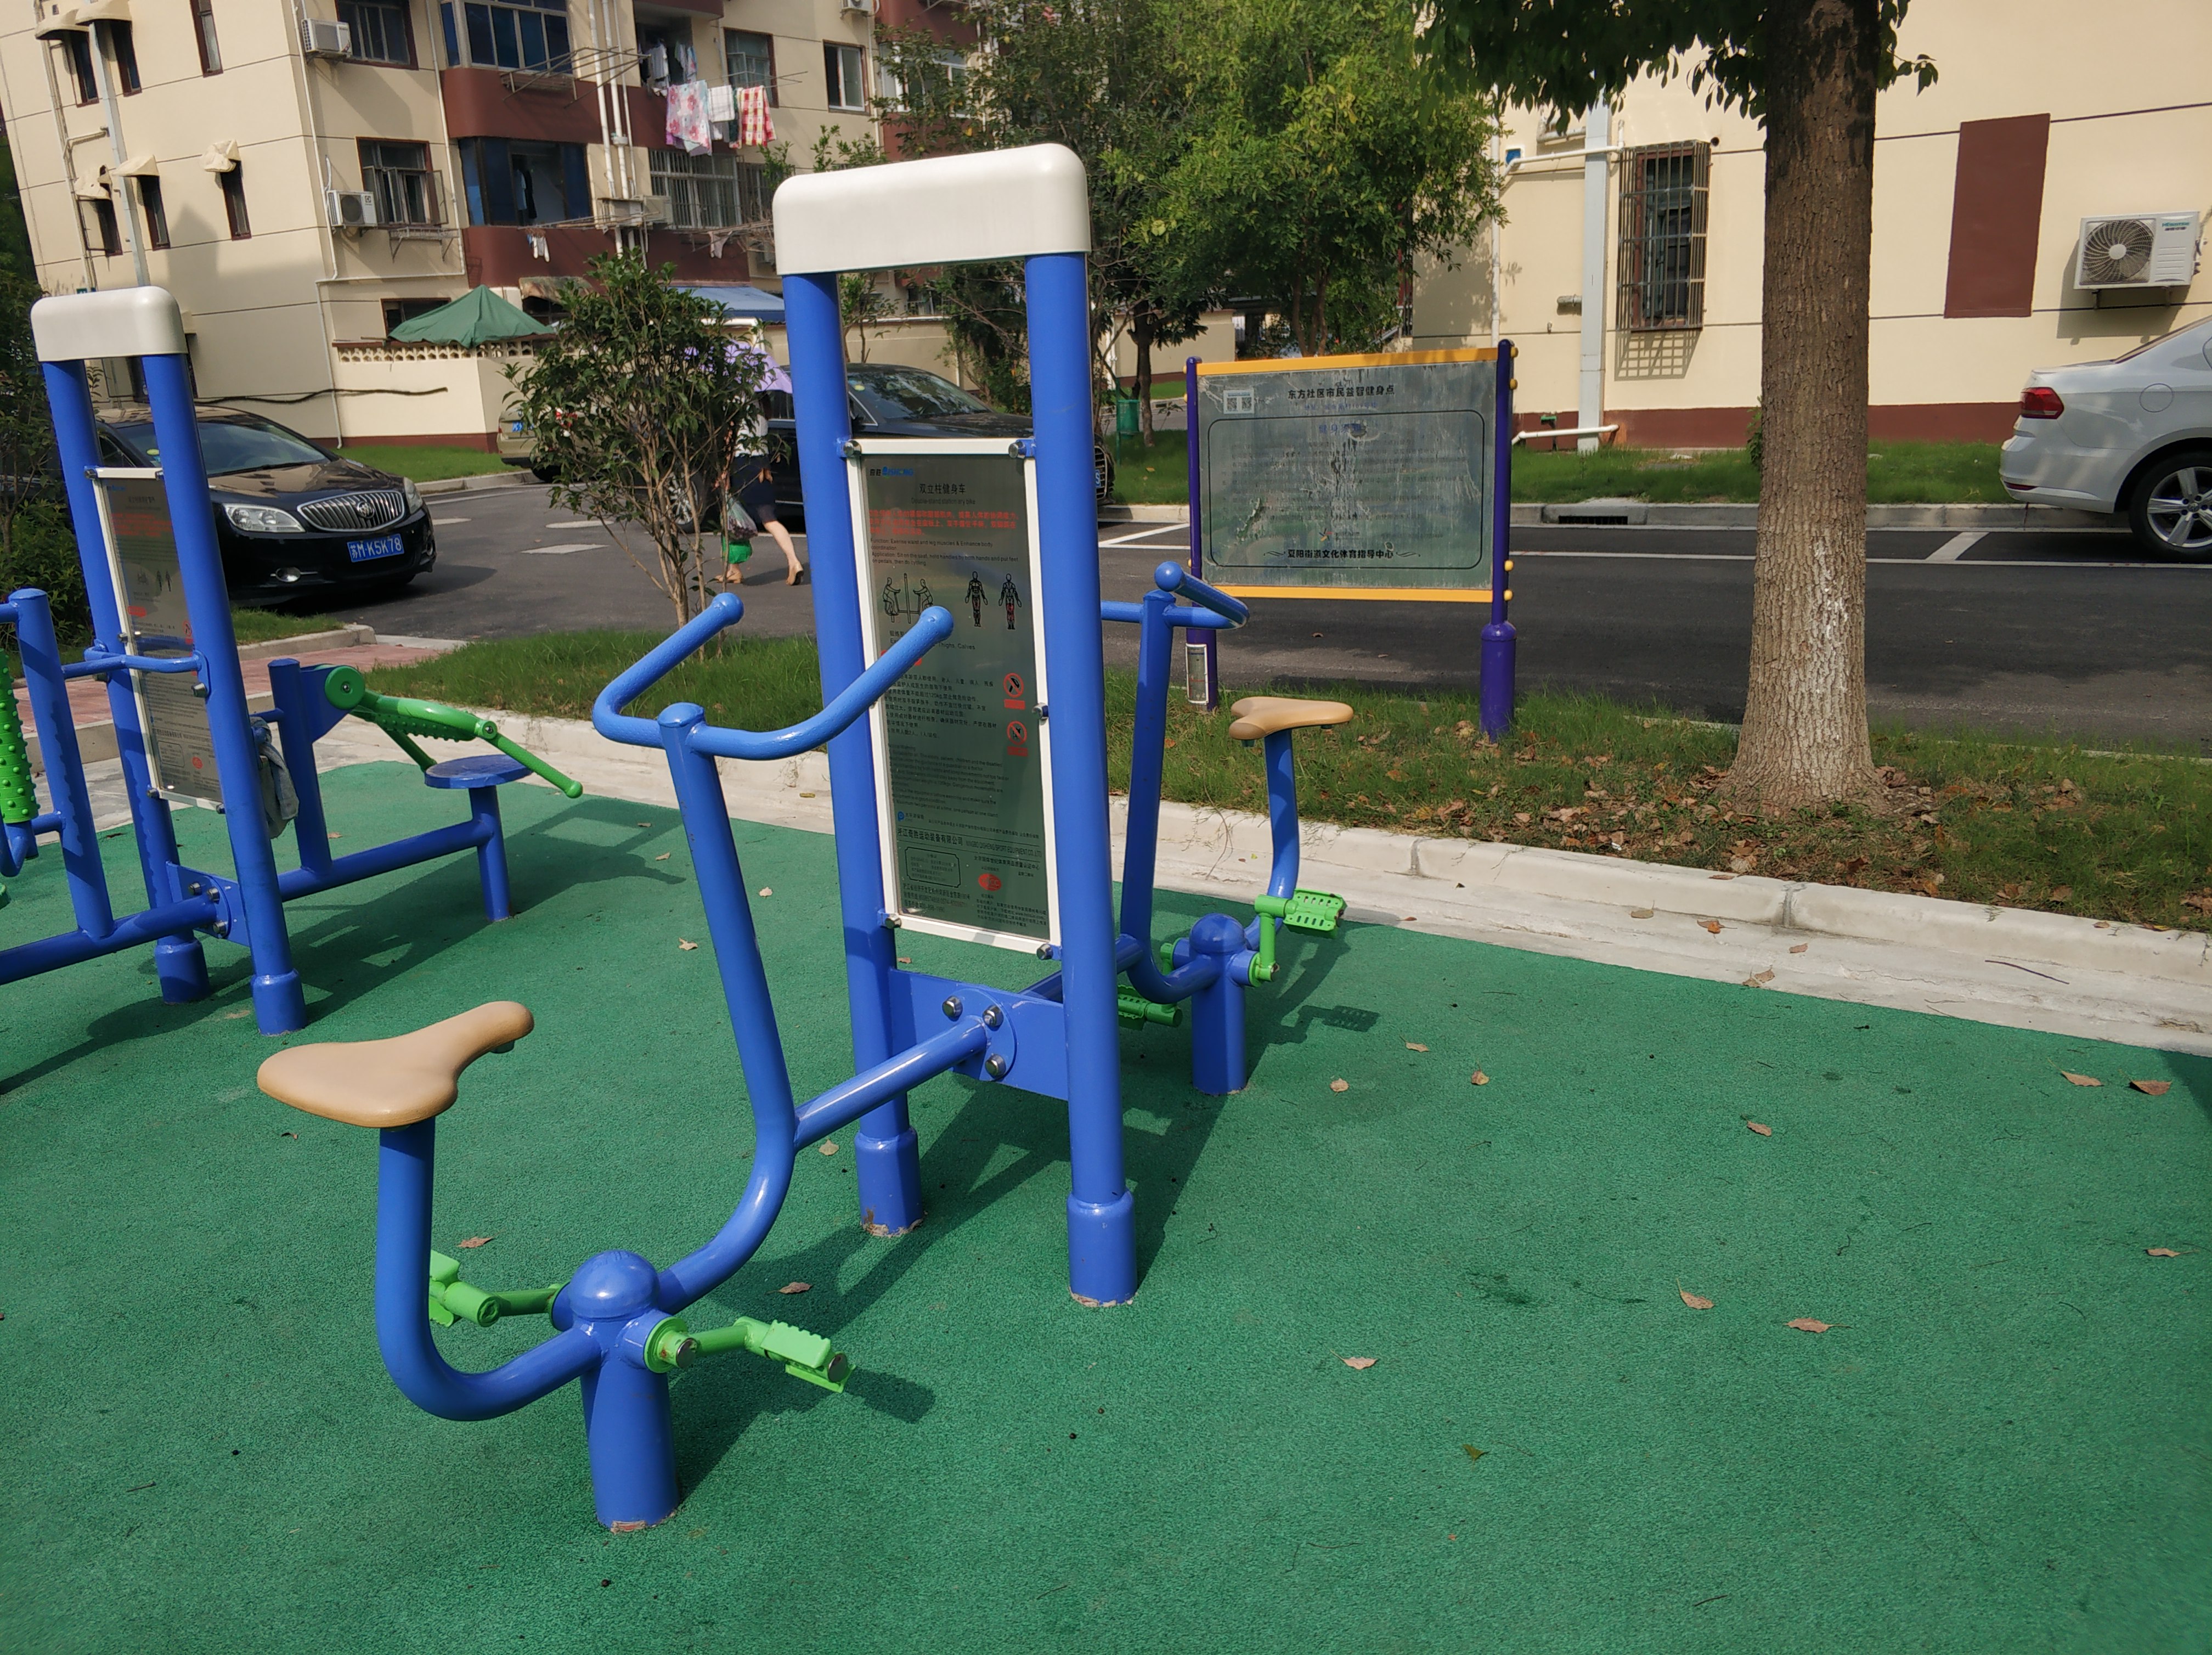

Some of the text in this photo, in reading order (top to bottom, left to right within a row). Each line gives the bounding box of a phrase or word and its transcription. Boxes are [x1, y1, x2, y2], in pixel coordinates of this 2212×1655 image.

[1288, 385, 1395, 399] 东方社区市民益智健身点
[918, 482, 966, 494] 双立柱健身车
[1287, 549, 1394, 559] 夏阳街道文化体育指导中心
[896, 827, 963, 846] 浙江奇胜运动装备有限公司
